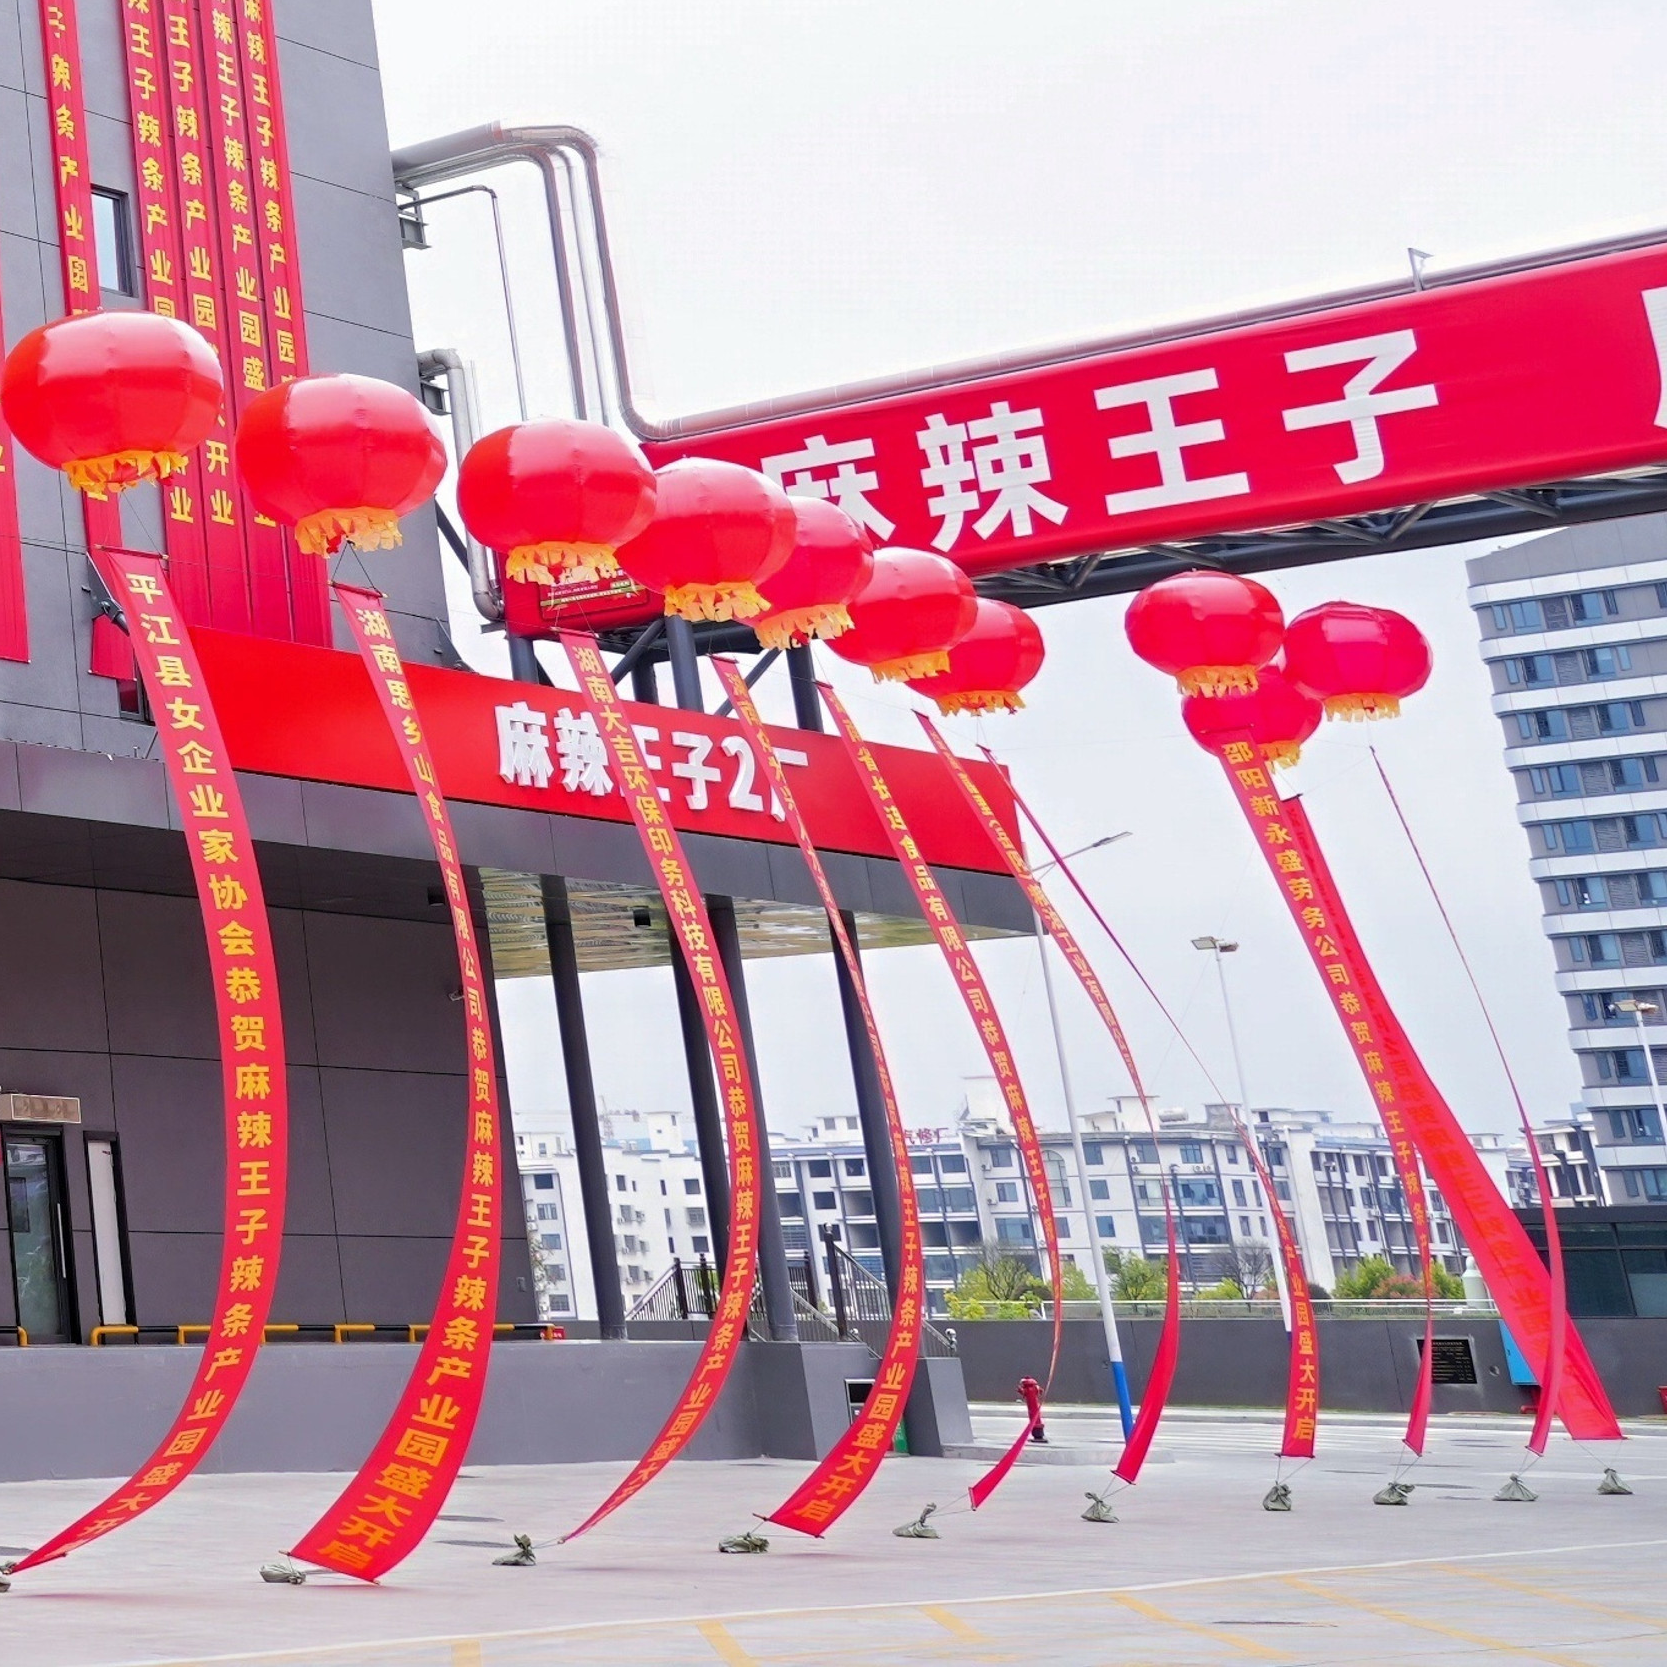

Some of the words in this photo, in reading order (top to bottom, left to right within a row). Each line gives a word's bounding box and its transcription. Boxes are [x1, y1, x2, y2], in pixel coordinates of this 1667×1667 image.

[52, 573, 272, 1555] 平江县女企业家协会恭贺麻辣王子辣条产业园盛大开
[578, 645, 754, 1511] 湖南大吉环保印务科技有限公司恭贺麻辣王子辣条产业园盛大
